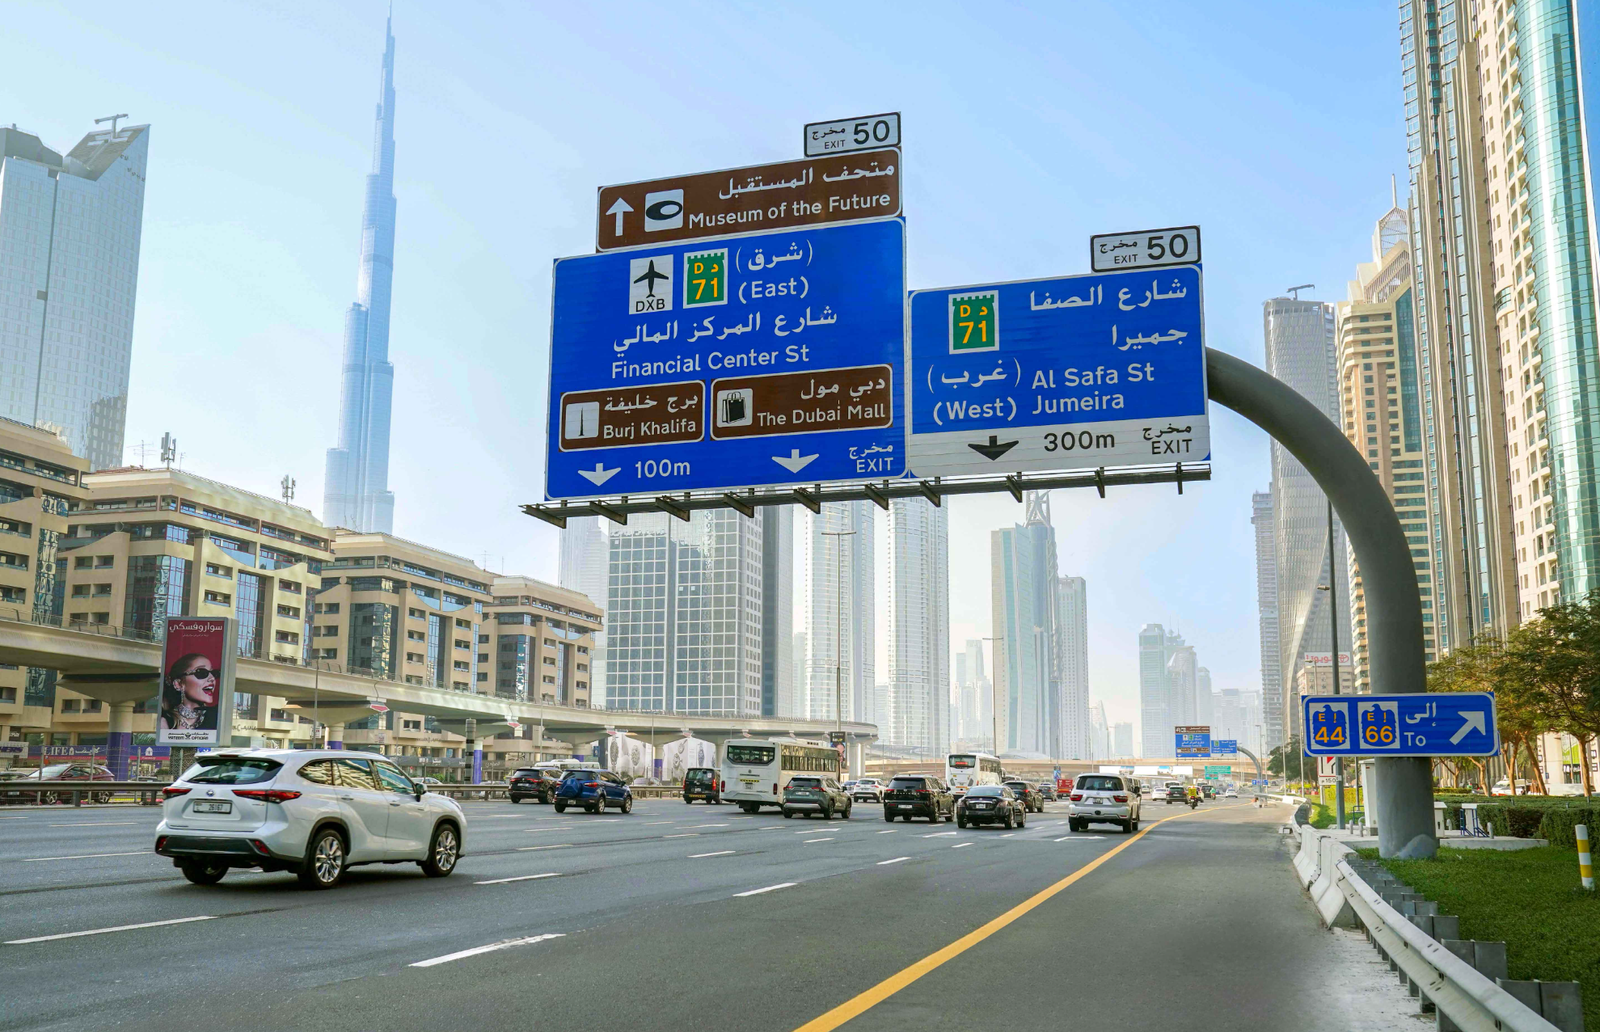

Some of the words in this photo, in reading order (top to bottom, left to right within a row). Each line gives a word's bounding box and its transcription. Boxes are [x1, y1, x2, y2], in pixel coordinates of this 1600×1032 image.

[812, 126, 846, 140] مخرج
[853, 120, 890, 145] 50
[824, 139, 846, 149] EXIT
[718, 166, 814, 200] المستقبل
[822, 161, 895, 183] متحف
[689, 209, 763, 229] Museum
[768, 201, 787, 219] of
[792, 199, 822, 217] the
[829, 192, 891, 212] Future
[1099, 239, 1138, 254] مخرج
[1147, 233, 1189, 261] 50
[694, 262, 704, 274] D
[1114, 253, 1138, 265] EXIT
[692, 277, 719, 300] 71
[738, 276, 809, 305] (East)
[1030, 283, 1103, 311] الصفا
[1118, 279, 1187, 312] شارع
[635, 299, 666, 313] DXB
[960, 305, 970, 317] D
[687, 311, 761, 343] المركز
[774, 305, 838, 336] شارع
[613, 319, 678, 358] المالي
[958, 320, 988, 345] 71
[1111, 324, 1188, 351] جميرا
[612, 350, 701, 379] Financial
[708, 348, 779, 371] Center
[785, 344, 810, 363] St
[1031, 369, 1056, 390] Al
[1064, 366, 1119, 387] Safa
[1127, 362, 1155, 382] St
[800, 378, 840, 400] مول
[849, 377, 886, 401] دبي
[604, 393, 658, 414] خليفة
[667, 393, 698, 414] برج
[933, 396, 1017, 426] (West)
[1032, 390, 1125, 415] Jumeira
[757, 411, 786, 427] The
[793, 405, 841, 423] Dubai
[848, 403, 886, 420] Mall
[604, 423, 635, 440] Burj
[641, 418, 696, 435] Khalifa
[1142, 422, 1192, 441] مخرج
[849, 442, 894, 460] مخرج
[1043, 430, 1115, 452] 300m
[1151, 438, 1193, 455] EXIT
[635, 458, 691, 479] 100m
[856, 457, 894, 473] EXIT
[1318, 713, 1326, 722] E
[1367, 712, 1375, 721] E
[1315, 726, 1345, 743] 44
[1365, 725, 1394, 743] 66
[1403, 731, 1427, 747] To
